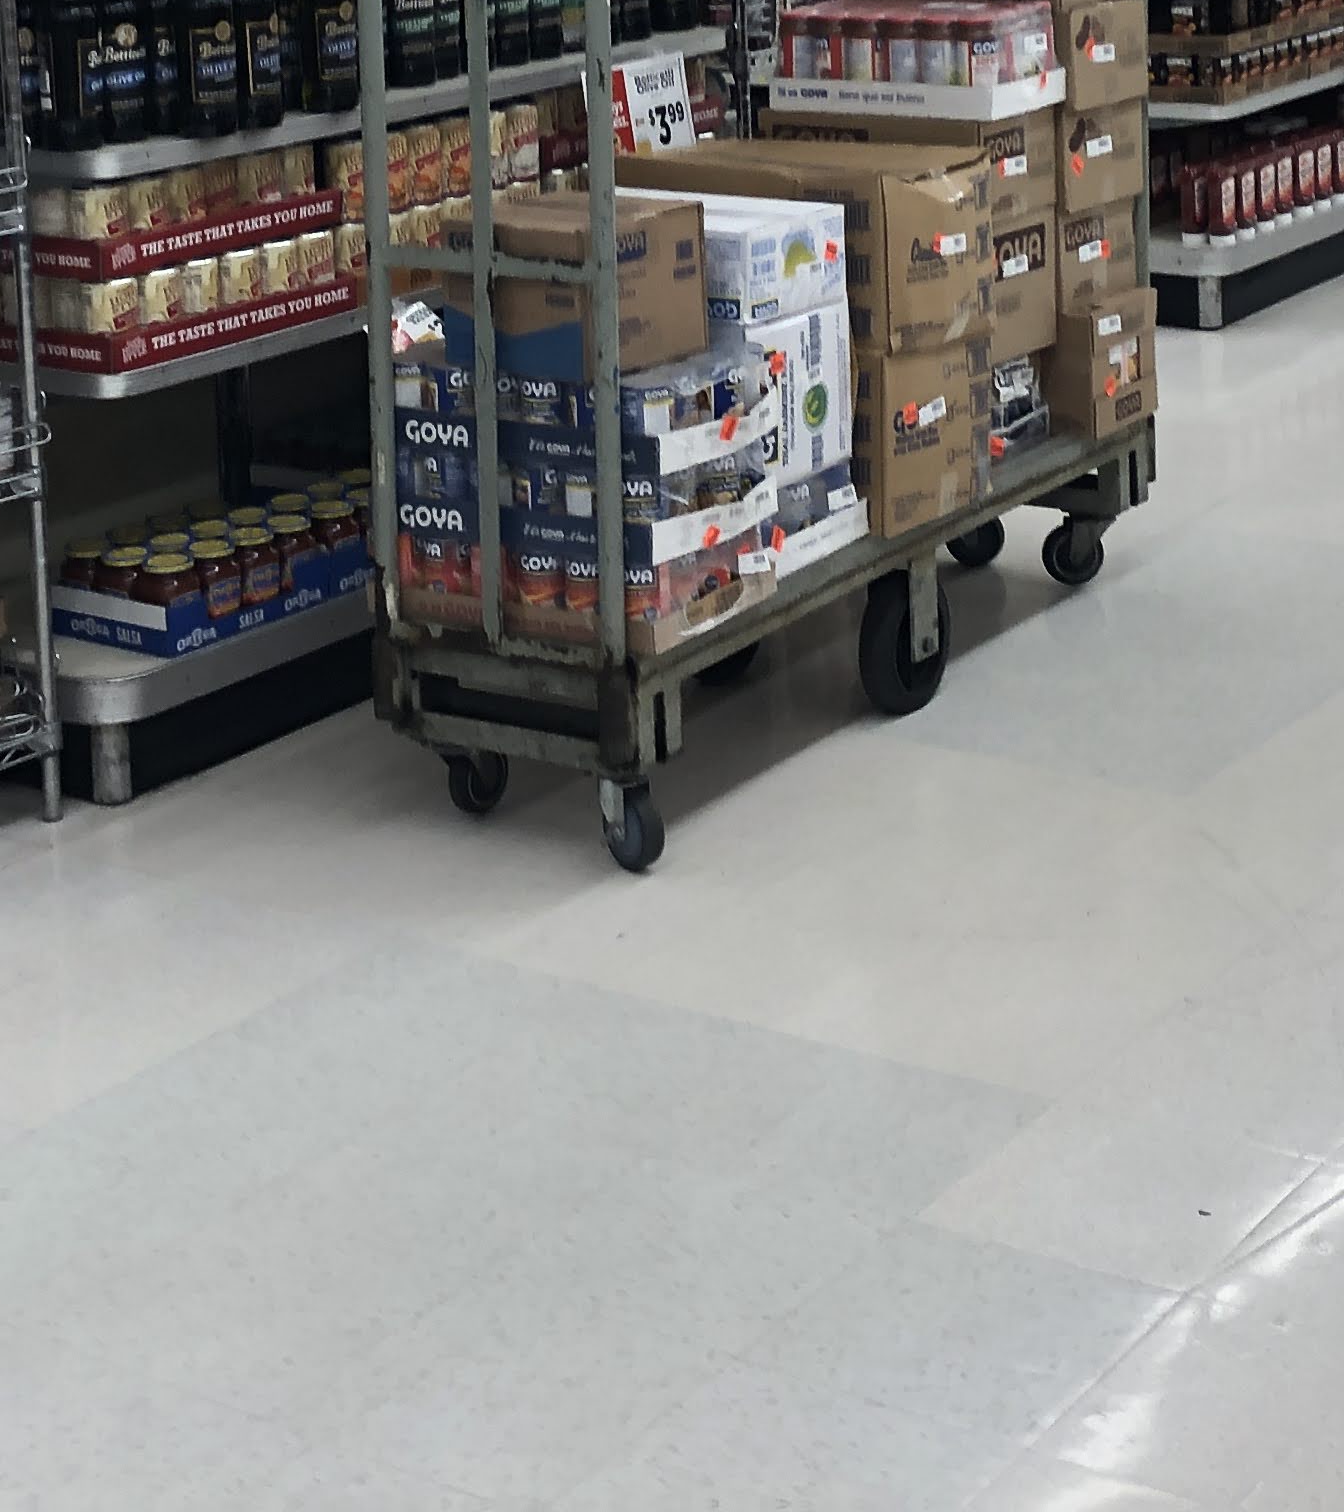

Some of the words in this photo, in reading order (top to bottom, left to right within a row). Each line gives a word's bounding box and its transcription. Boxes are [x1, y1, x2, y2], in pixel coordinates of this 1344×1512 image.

[800, 88, 829, 99] GOYA
[141, 240, 166, 258] THE
[166, 234, 203, 256] TASTE
[204, 221, 235, 242] THAT
[237, 212, 272, 235] TAKES
[274, 207, 298, 225] YOU
[299, 199, 334, 219] HOME
[616, 233, 646, 251] OYA
[1000, 231, 1043, 266] OYA
[58, 254, 93, 269] HOME
[151, 332, 177, 351] THE
[177, 323, 216, 344] TASTE
[217, 314, 249, 334] THAT
[249, 304, 288, 326] TAKES
[288, 296, 313, 314] YOU
[314, 286, 351, 307] HOME
[522, 380, 558, 398] OYA
[406, 419, 470, 449] GOYA
[400, 504, 464, 532] GOYA
[239, 609, 265, 630] SALSA
[116, 626, 143, 647] SALSA
